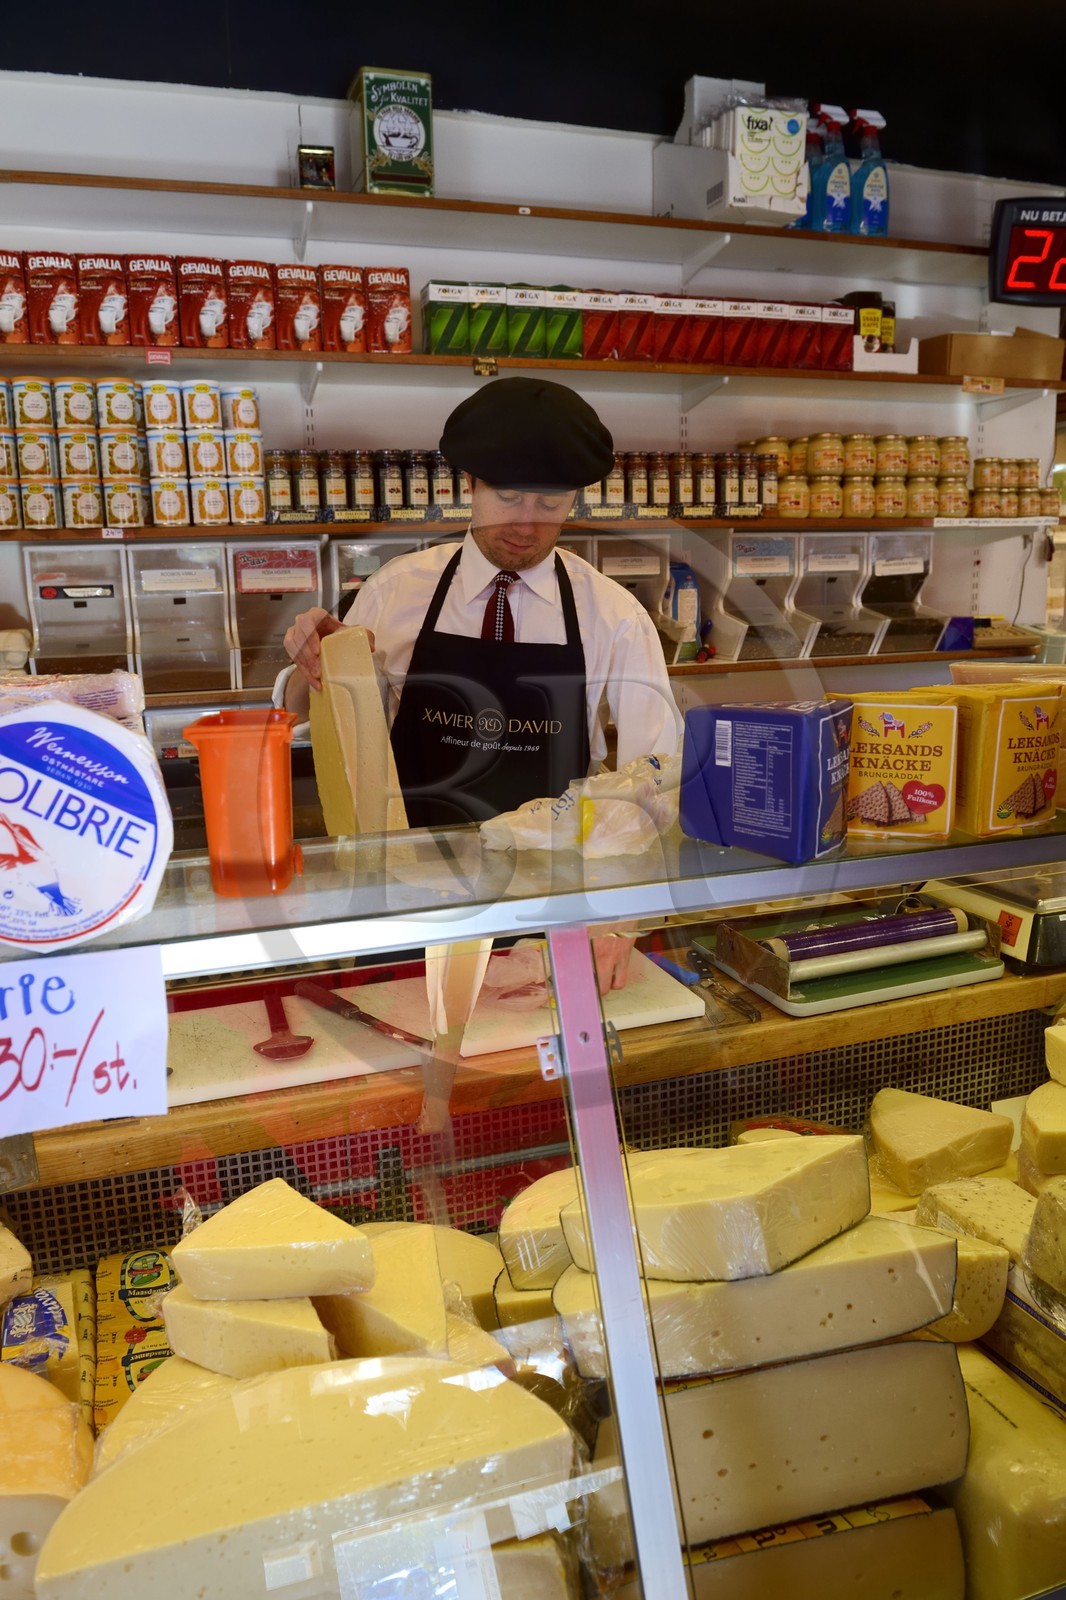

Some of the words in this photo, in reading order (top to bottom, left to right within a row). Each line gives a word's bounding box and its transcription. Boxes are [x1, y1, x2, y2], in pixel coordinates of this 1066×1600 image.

[1021, 210, 1039, 221] NU
[28, 256, 73, 270] GEVALIA
[79, 259, 122, 271] GEVALIA
[129, 259, 172, 273] GEVALIA
[181, 263, 222, 277] GEVALIA
[229, 266, 269, 279] GEVALIA
[278, 268, 317, 281] GEVALIA
[324, 270, 362, 283] GEVALIA
[368, 272, 407, 285] GEVALIA
[422, 708, 474, 729] XAVIER
[509, 719, 563, 734] DAVID
[440, 736, 469, 747] Affineur
[470, 739, 480, 748] de
[482, 741, 501, 751] goût
[501, 742, 523, 753] depuis
[852, 756, 932, 772] KNÄCKE
[907, 794, 938, 806] Fullkorn
[914, 789, 935, 799] 100%
